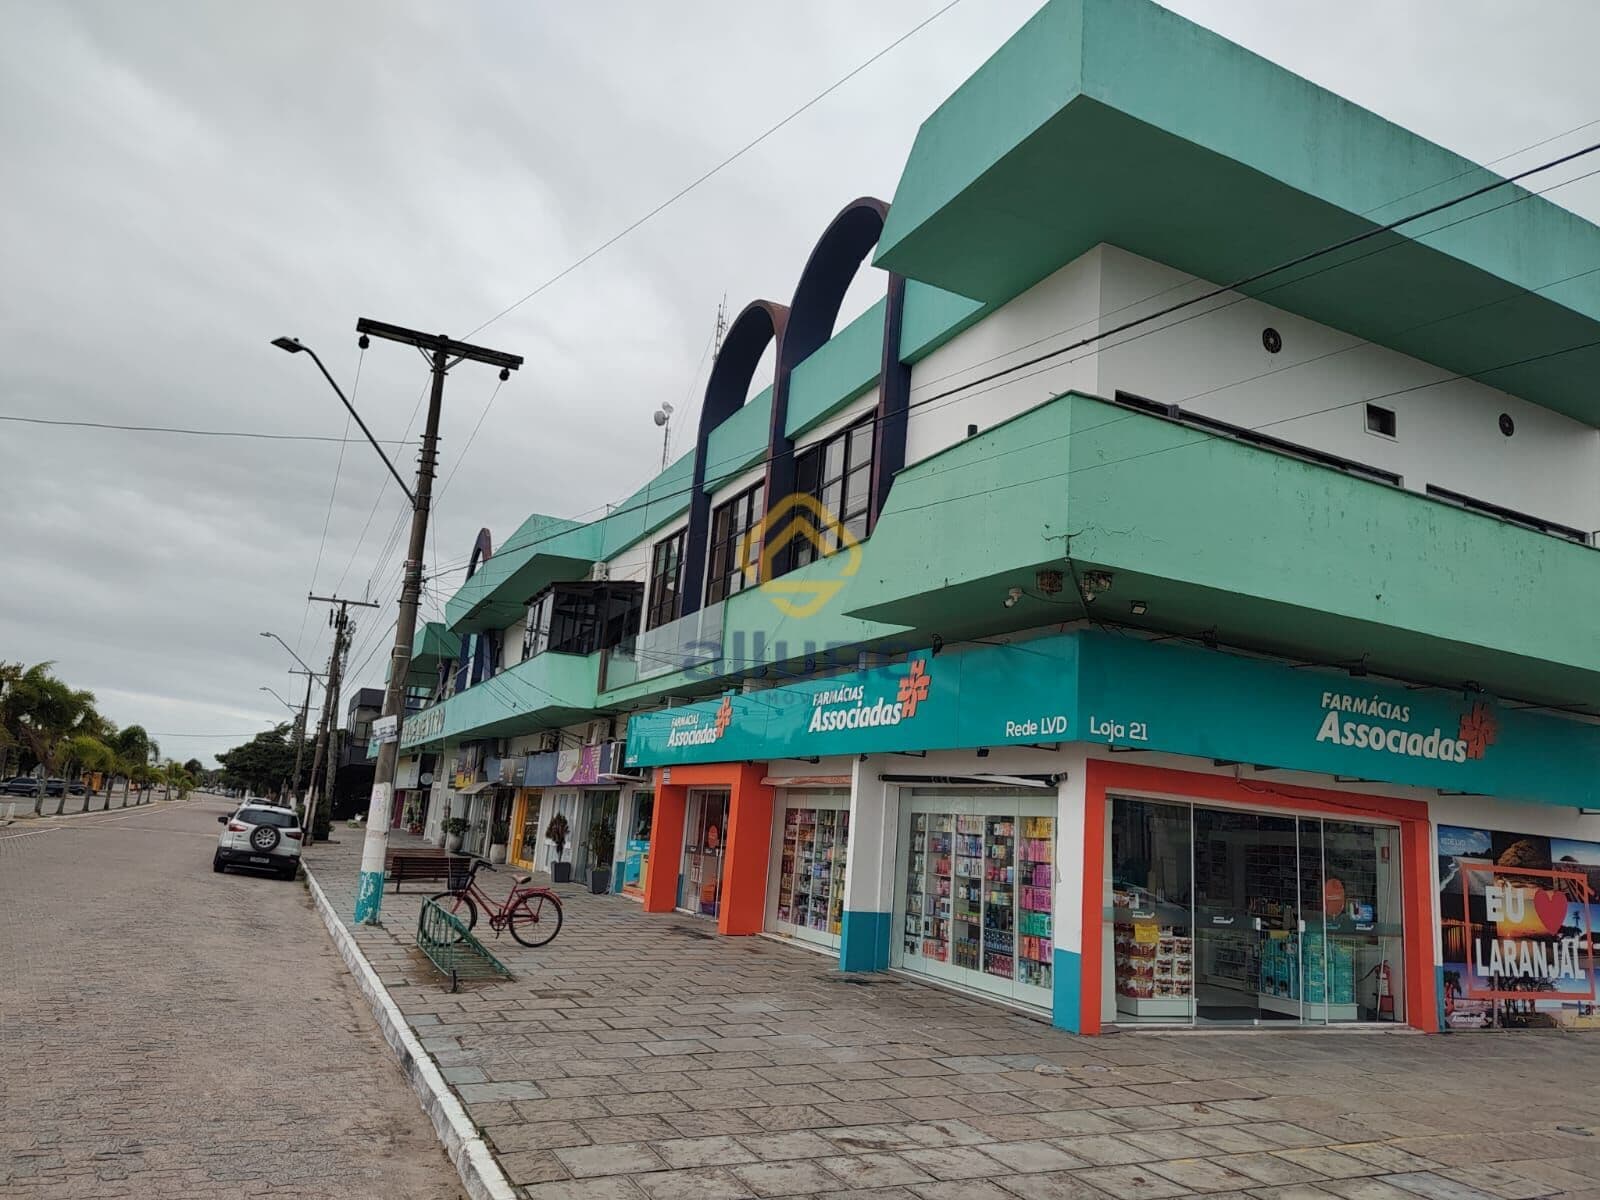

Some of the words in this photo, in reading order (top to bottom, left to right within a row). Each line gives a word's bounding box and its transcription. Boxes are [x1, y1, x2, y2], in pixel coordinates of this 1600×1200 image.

[812, 684, 864, 706] FARMÁCIAS
[1321, 692, 1410, 722] FARMÁCIAS
[809, 697, 902, 732] Associadas
[1005, 719, 1038, 737] Rede
[1041, 716, 1067, 735] LVD
[1090, 716, 1125, 742] Loja
[1129, 722, 1148, 741] 21
[667, 723, 717, 747] Associadas
[1315, 711, 1467, 763] Associadas
[1485, 884, 1525, 923] EU
[1476, 935, 1586, 980] LARANJAL
